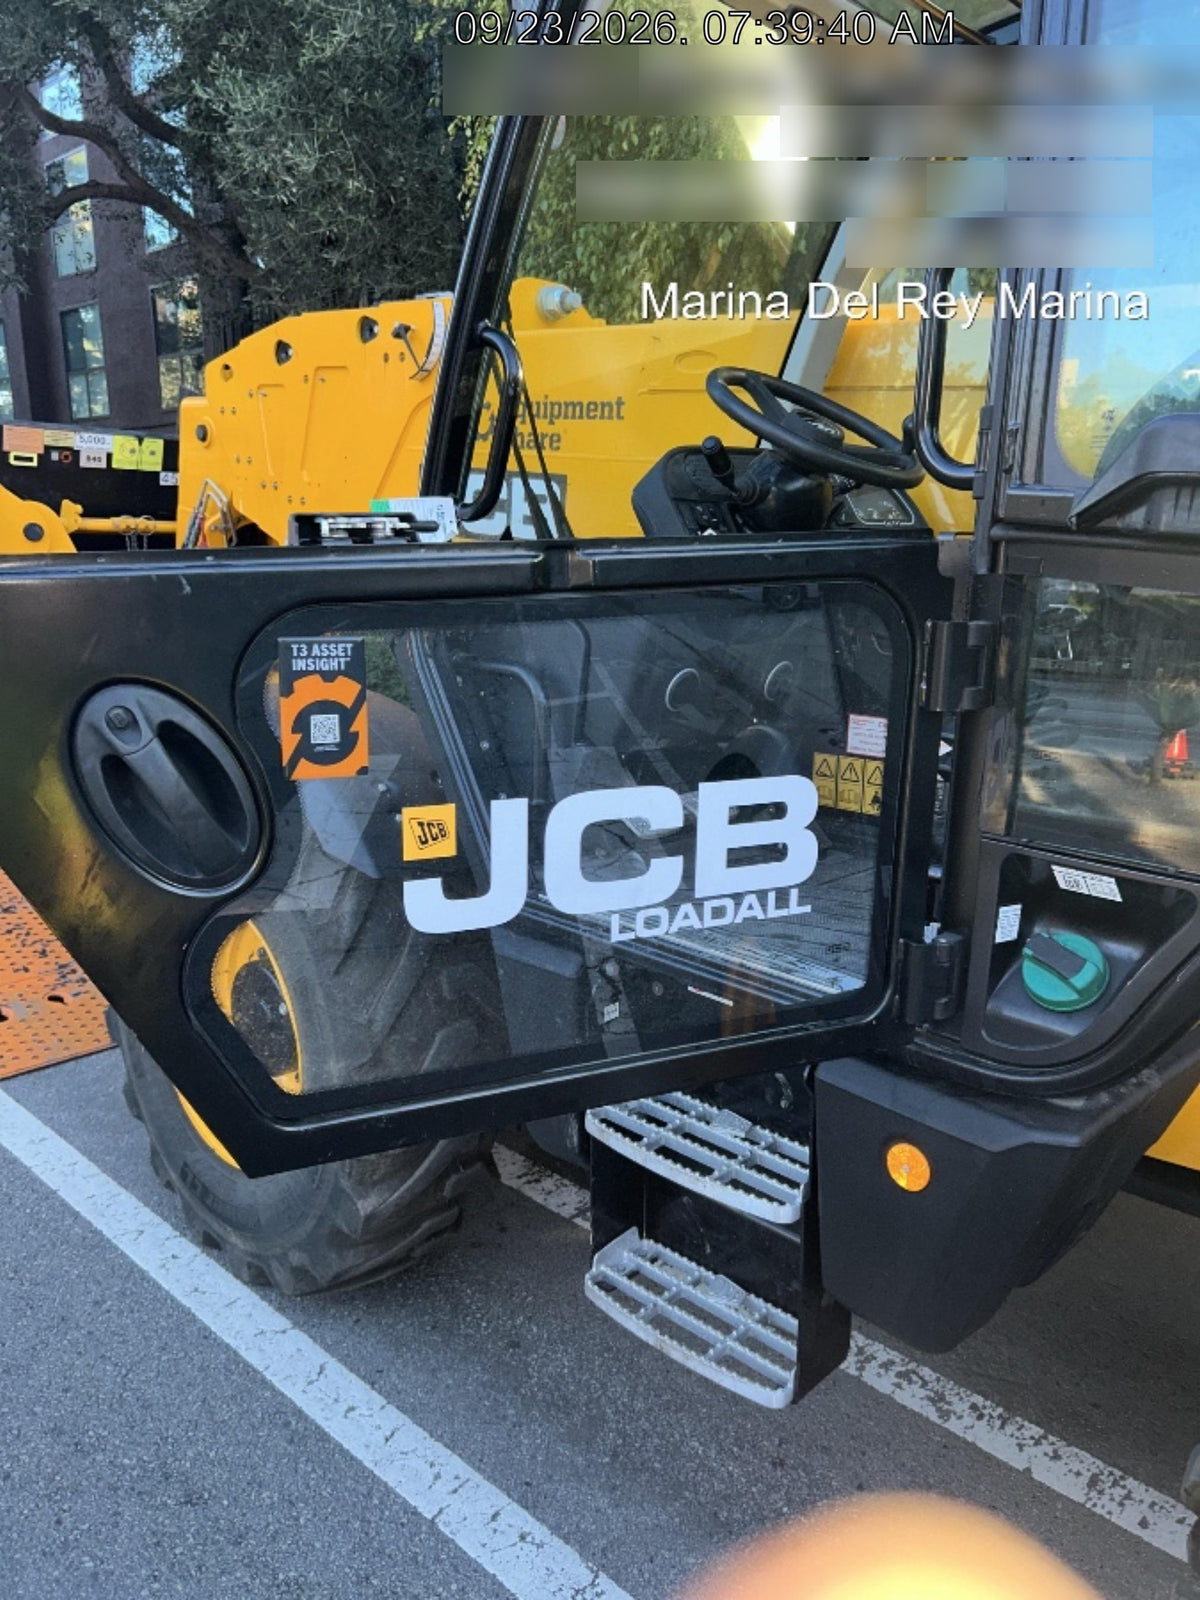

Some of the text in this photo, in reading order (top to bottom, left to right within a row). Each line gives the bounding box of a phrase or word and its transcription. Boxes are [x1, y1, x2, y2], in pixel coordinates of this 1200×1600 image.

[516, 396, 625, 423] quipment
[515, 429, 561, 450] hare
[290, 643, 354, 657] T3 ASSET
[416, 816, 448, 846] JCB
[403, 775, 819, 934] JCB
[609, 888, 812, 943] LOADALL
